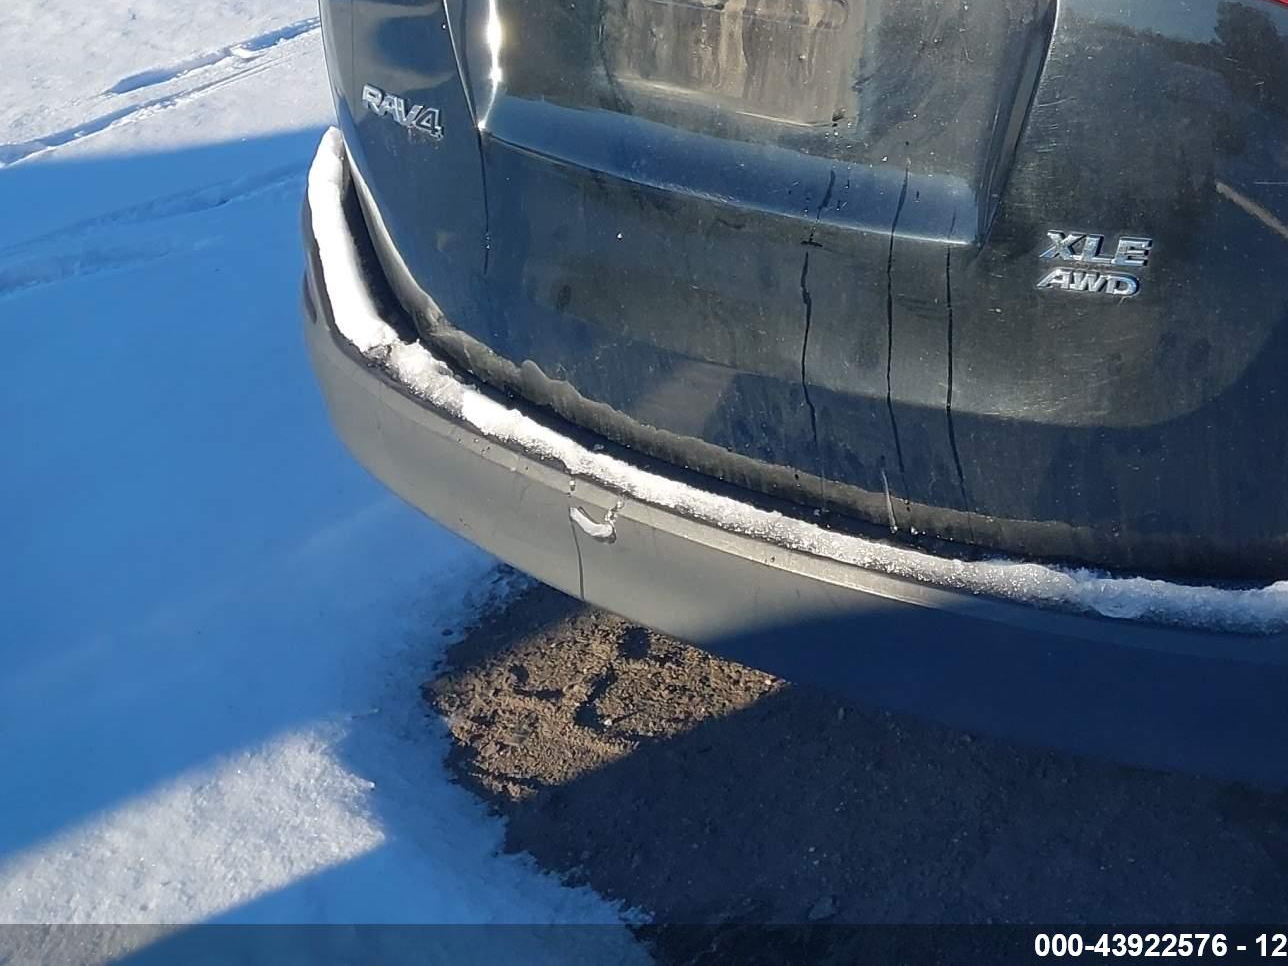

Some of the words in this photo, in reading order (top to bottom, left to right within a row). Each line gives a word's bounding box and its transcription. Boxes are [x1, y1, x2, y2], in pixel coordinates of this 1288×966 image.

[362, 84, 445, 140] RAV4
[1040, 229, 1153, 266] XLE
[1037, 266, 1140, 297] AWD
